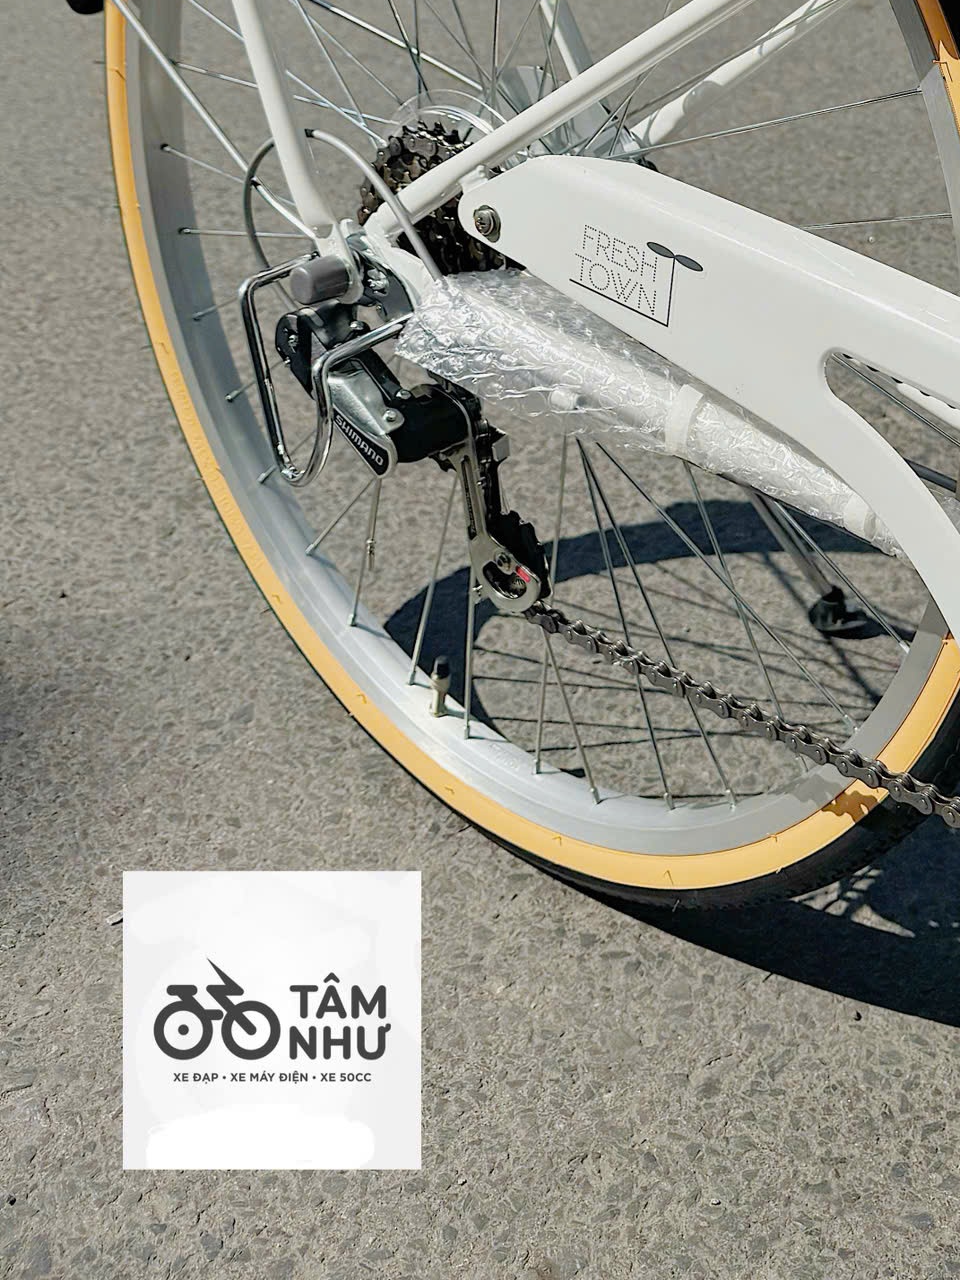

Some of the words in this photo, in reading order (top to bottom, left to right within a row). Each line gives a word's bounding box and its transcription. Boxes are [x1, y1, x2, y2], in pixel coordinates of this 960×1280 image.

[582, 224, 658, 283] FRESH
[574, 252, 657, 316] TOWN
[335, 414, 384, 466] SHIMANO
